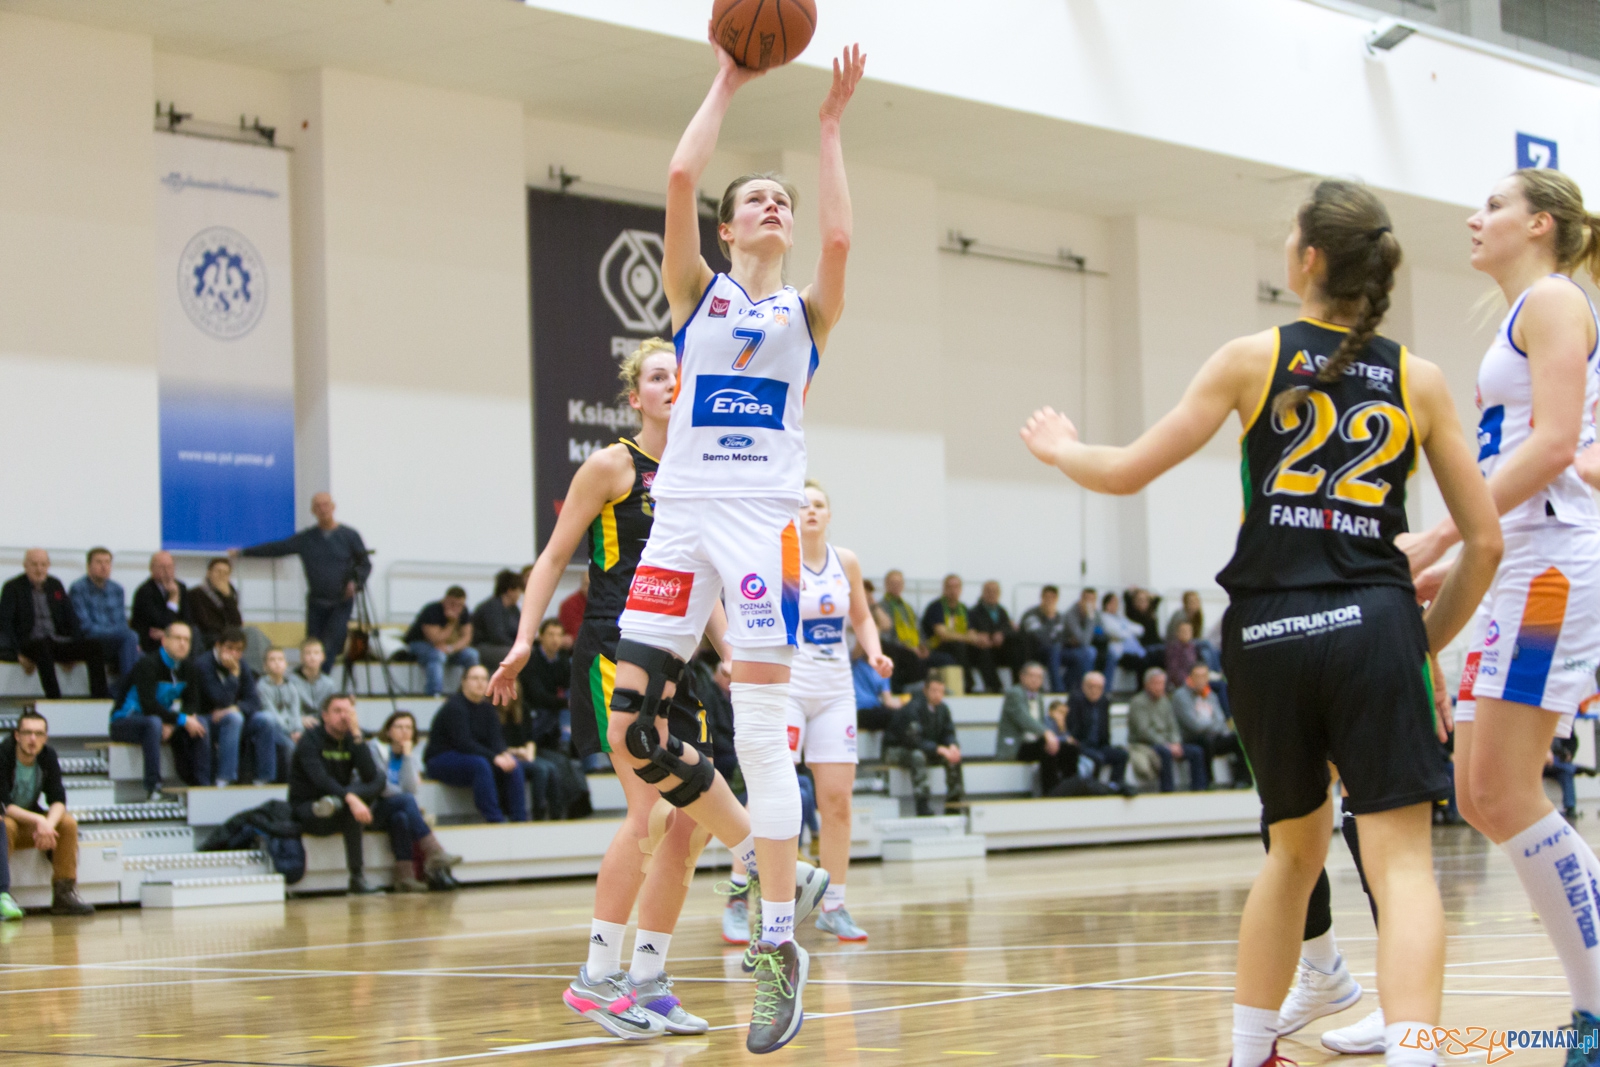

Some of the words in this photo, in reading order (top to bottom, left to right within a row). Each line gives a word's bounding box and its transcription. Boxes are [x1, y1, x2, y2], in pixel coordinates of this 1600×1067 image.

[732, 327, 766, 371] 7
[568, 399, 642, 433] Książk
[711, 397, 773, 416] Enea
[724, 437, 749, 447] Ford
[1262, 386, 1411, 507] 22
[702, 453, 730, 461] Bemo
[731, 453, 768, 462] Motors
[632, 582, 680, 599] SZPIKU
[820, 594, 835, 616] 6
[1242, 604, 1362, 642] KONSTRUKTOR
